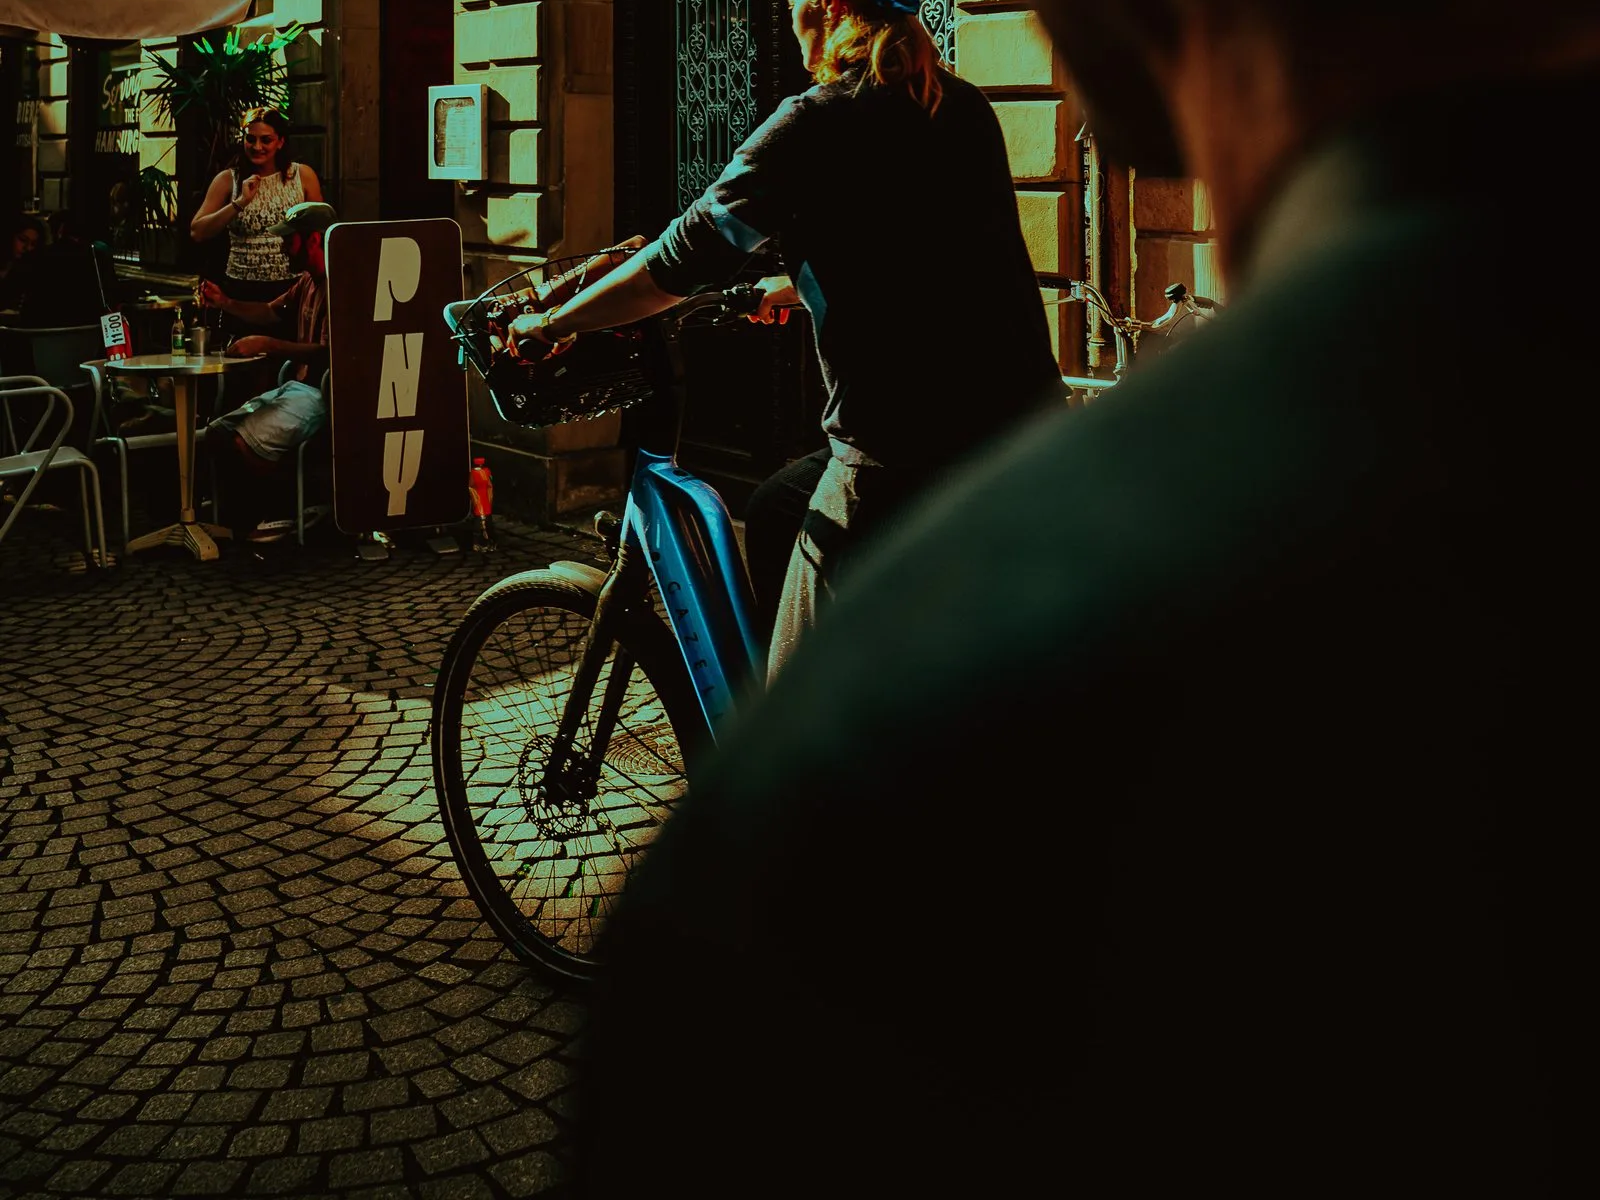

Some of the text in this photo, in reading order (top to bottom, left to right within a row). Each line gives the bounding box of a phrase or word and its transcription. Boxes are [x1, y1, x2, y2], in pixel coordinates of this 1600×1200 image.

[124, 108, 135, 123] THE
[95, 129, 140, 154] HAMBURG
[108, 314, 123, 344] 11:00
[373, 236, 425, 516] PNY
